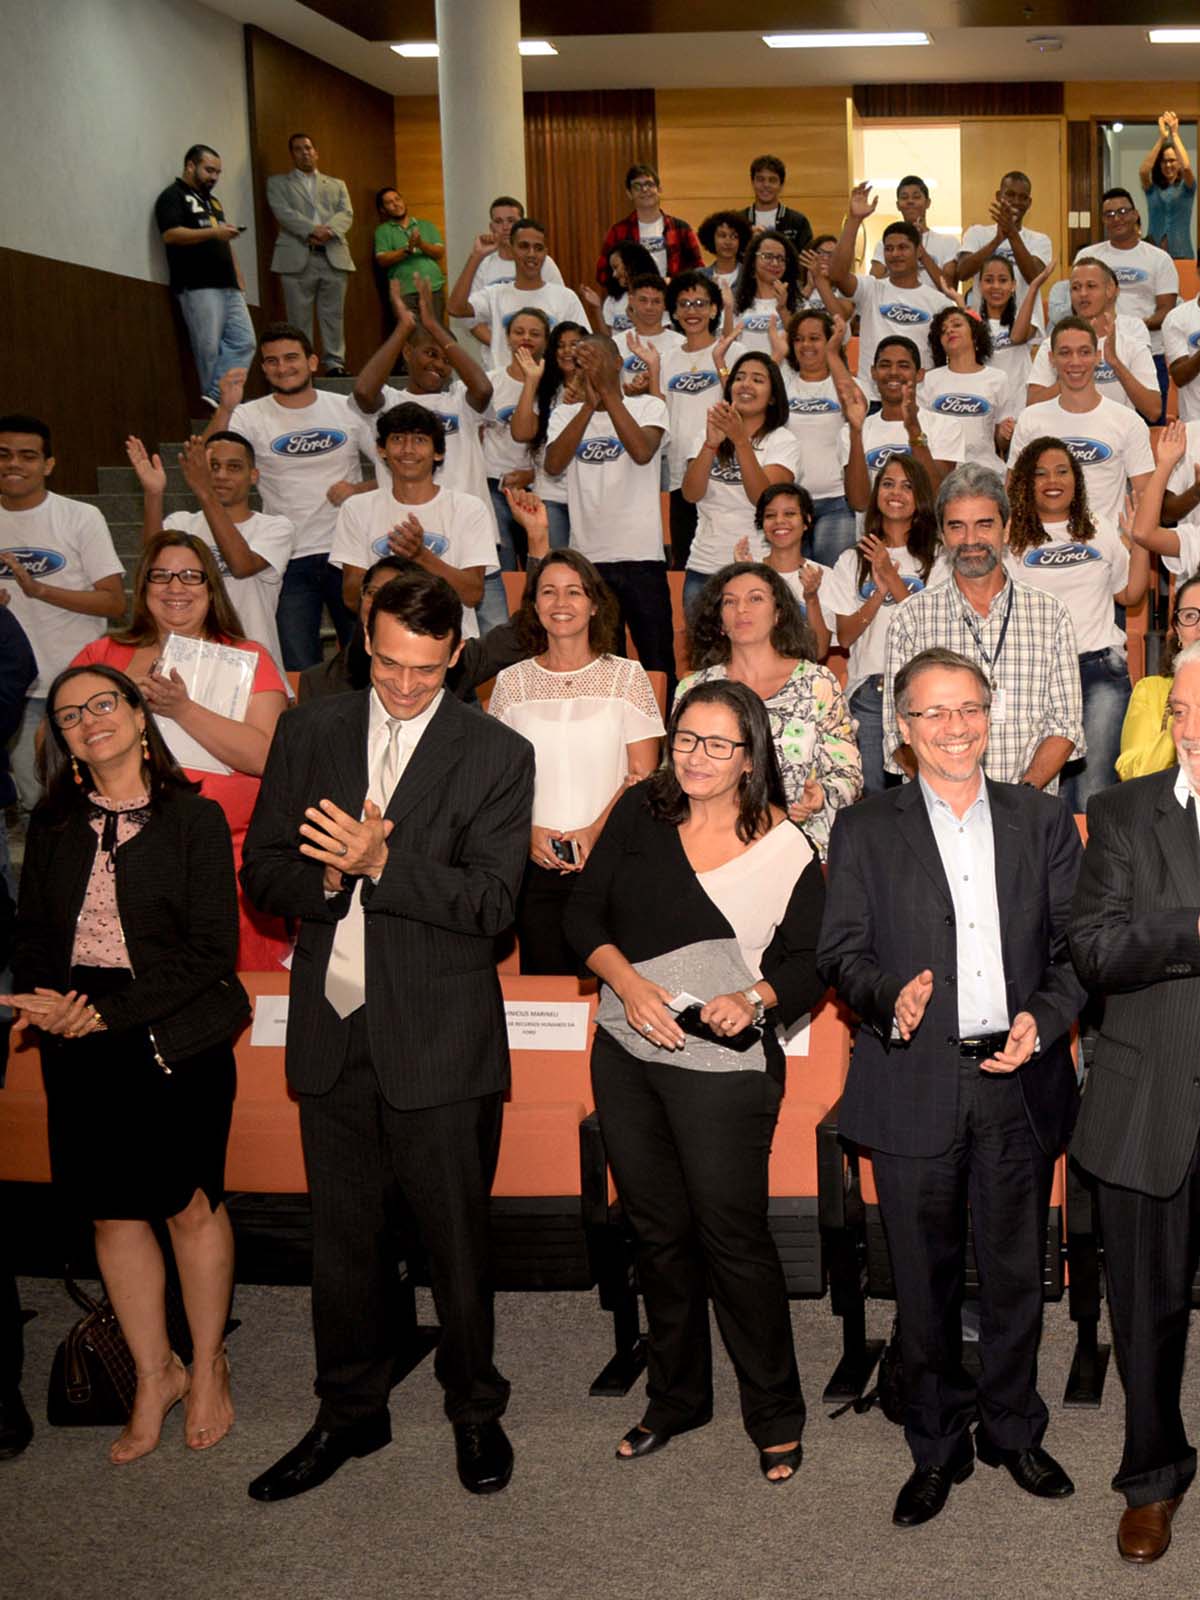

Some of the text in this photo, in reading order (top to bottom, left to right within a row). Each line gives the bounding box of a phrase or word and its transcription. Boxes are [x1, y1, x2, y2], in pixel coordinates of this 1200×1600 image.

[888, 305, 920, 322] Ford
[676, 373, 711, 391] Ford
[789, 399, 829, 411] Ford
[941, 397, 980, 413] Ford
[287, 432, 332, 453] Ford
[1040, 547, 1089, 564] Ford
